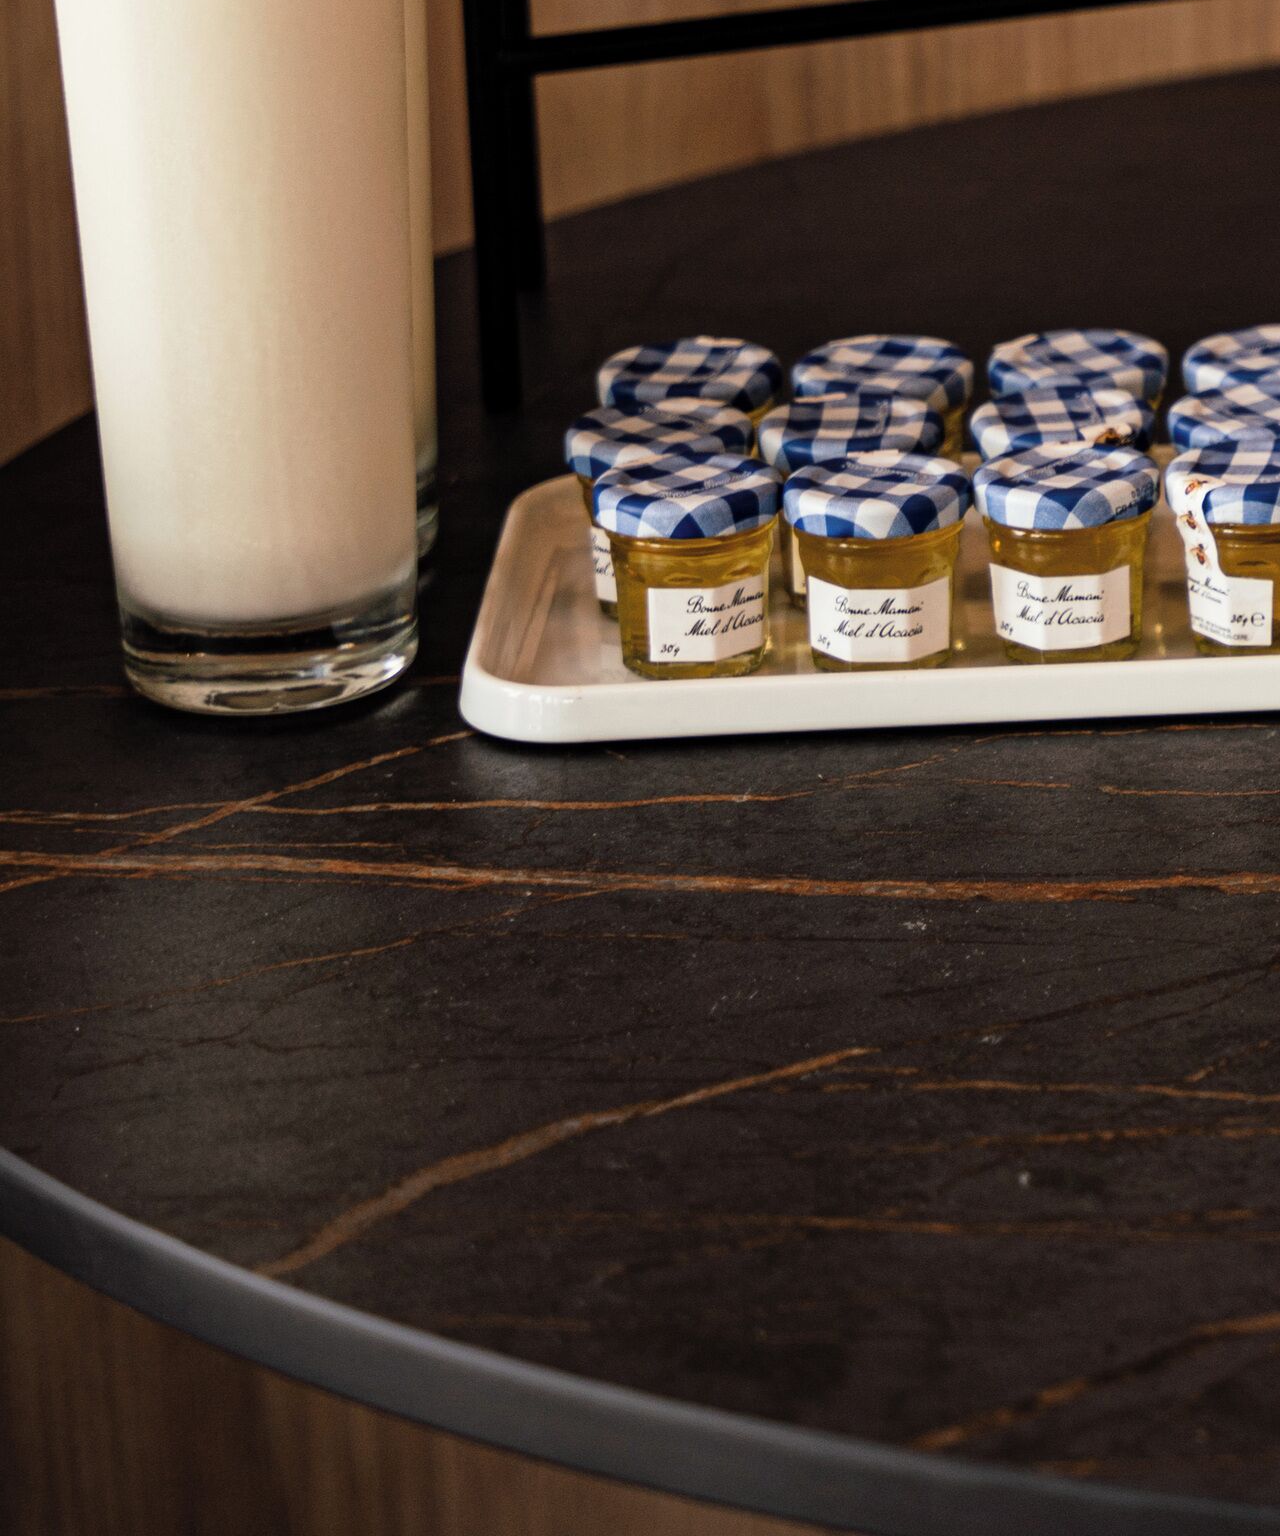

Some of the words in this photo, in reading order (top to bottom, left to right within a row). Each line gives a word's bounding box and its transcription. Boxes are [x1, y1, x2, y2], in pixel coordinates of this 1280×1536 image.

[1016, 580, 1048, 603] Bonne
[1049, 584, 1104, 604] Maman
[686, 594, 726, 614] Bonne
[834, 595, 872, 615] Bonne
[872, 597, 923, 616] Maman
[1043, 607, 1105, 626] d'Acacia
[684, 618, 721, 637] Miel
[833, 618, 863, 639] Miel
[865, 619, 924, 639] d'Acacia
